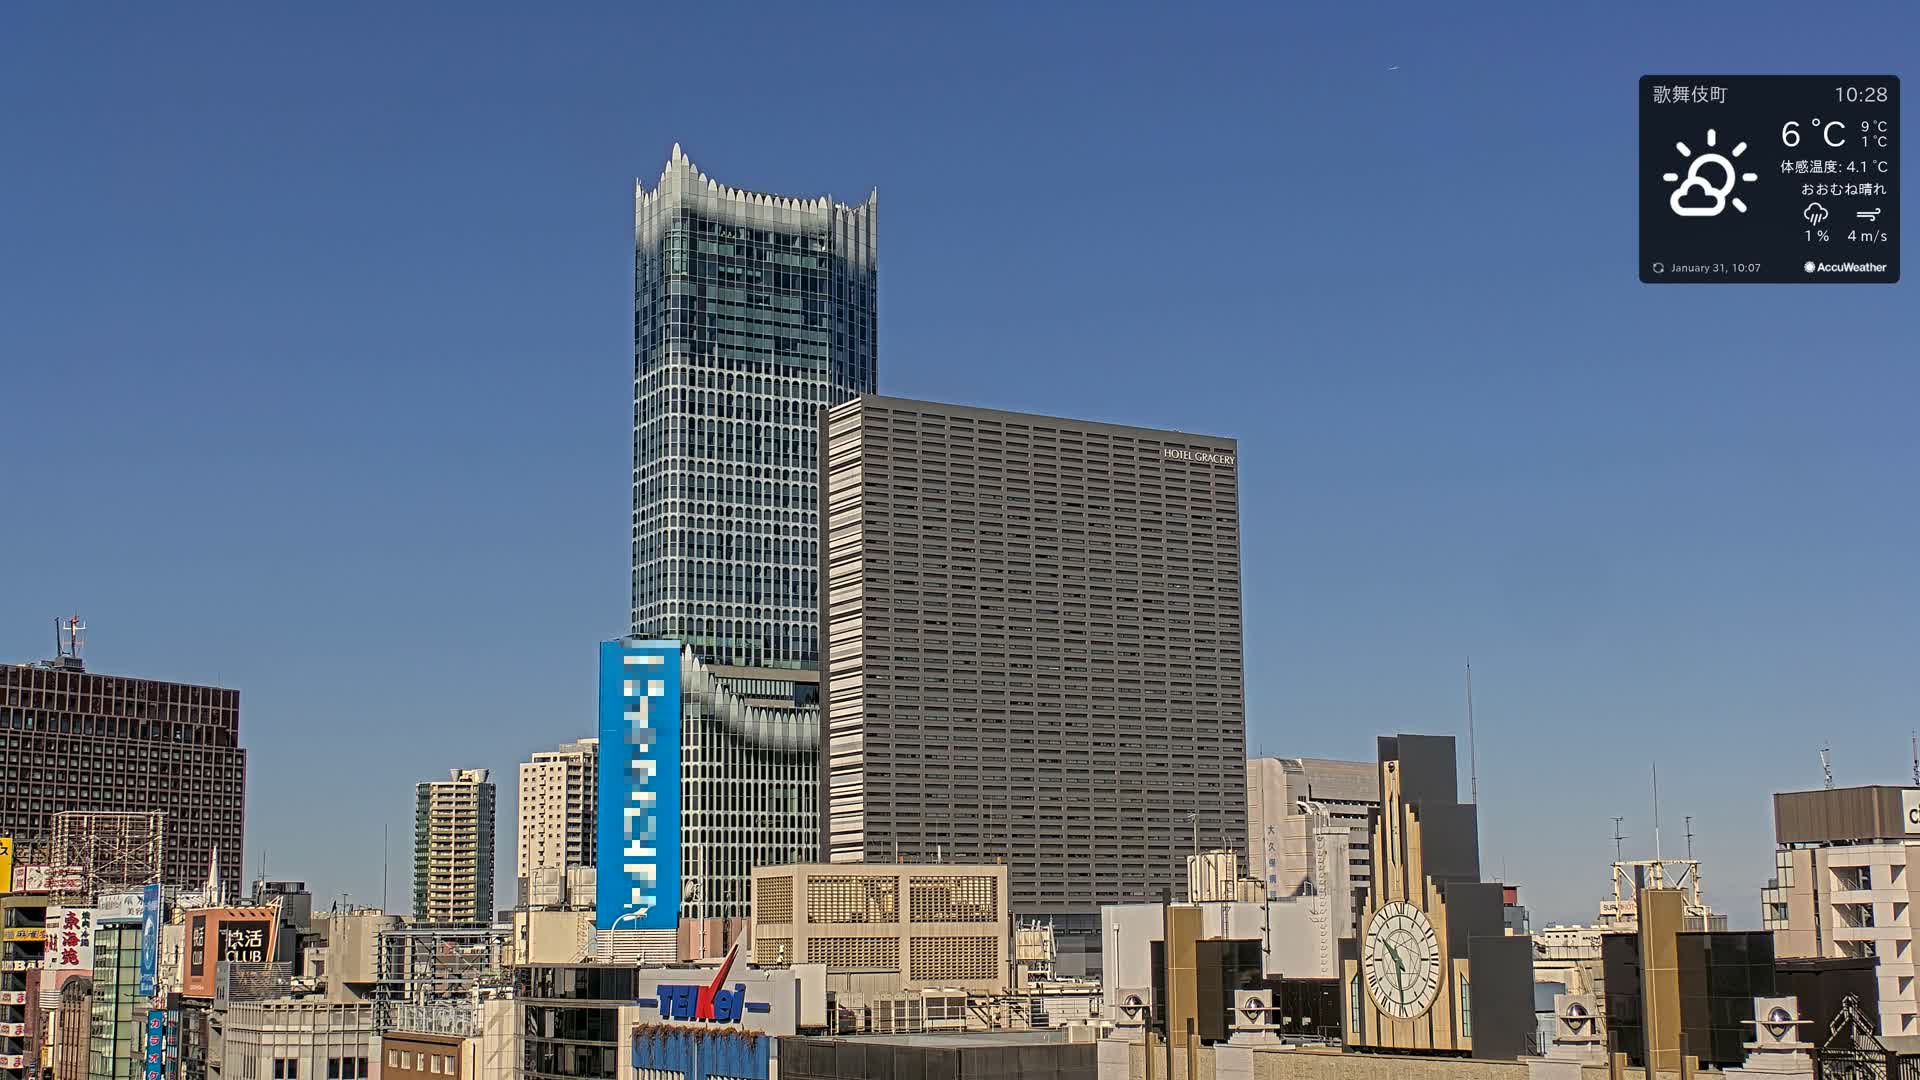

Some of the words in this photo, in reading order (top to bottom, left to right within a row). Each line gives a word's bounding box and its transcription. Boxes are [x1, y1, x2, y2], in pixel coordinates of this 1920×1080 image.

[1164, 449, 1193, 461] HOTEL
[1194, 452, 1236, 465] GRACERY
[227, 929, 263, 948] 快活
[226, 950, 262, 963] CLUB
[148, 1018, 161, 1080] カラオケ
